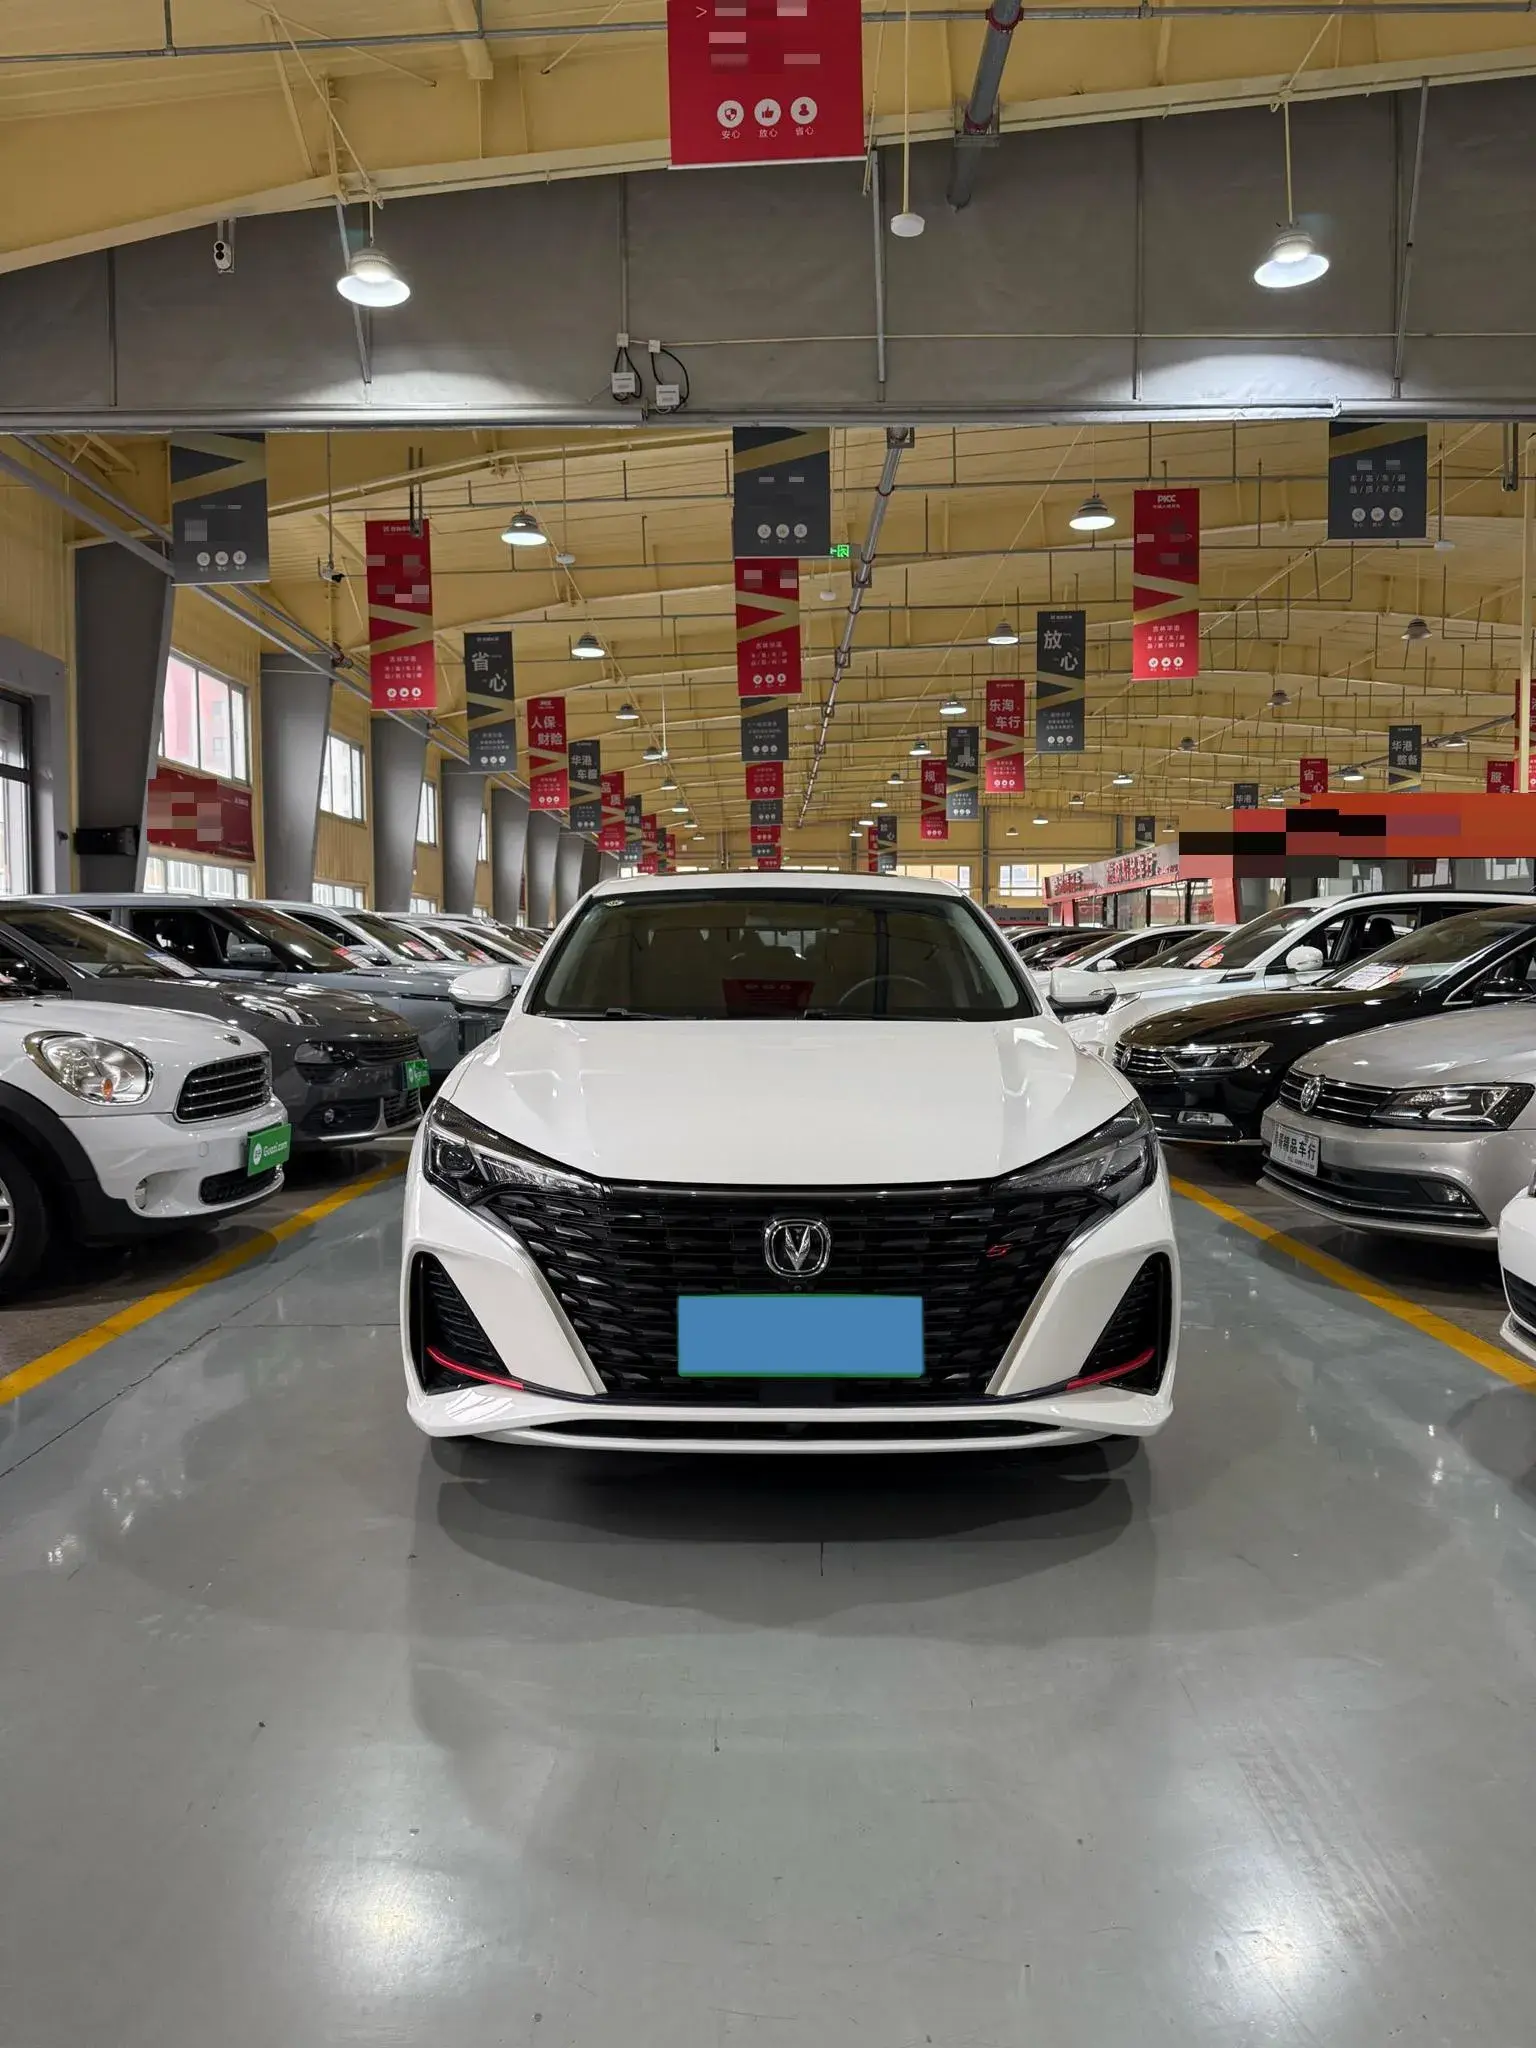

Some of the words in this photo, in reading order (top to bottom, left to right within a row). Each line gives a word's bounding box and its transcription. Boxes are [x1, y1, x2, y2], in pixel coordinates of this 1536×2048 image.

[721, 129, 741, 140] 安心
[758, 128, 778, 138] 放心
[795, 126, 814, 137] 省心
[530, 715, 557, 730] 人保
[995, 715, 1021, 730] 车行
[537, 732, 563, 747] 财险
